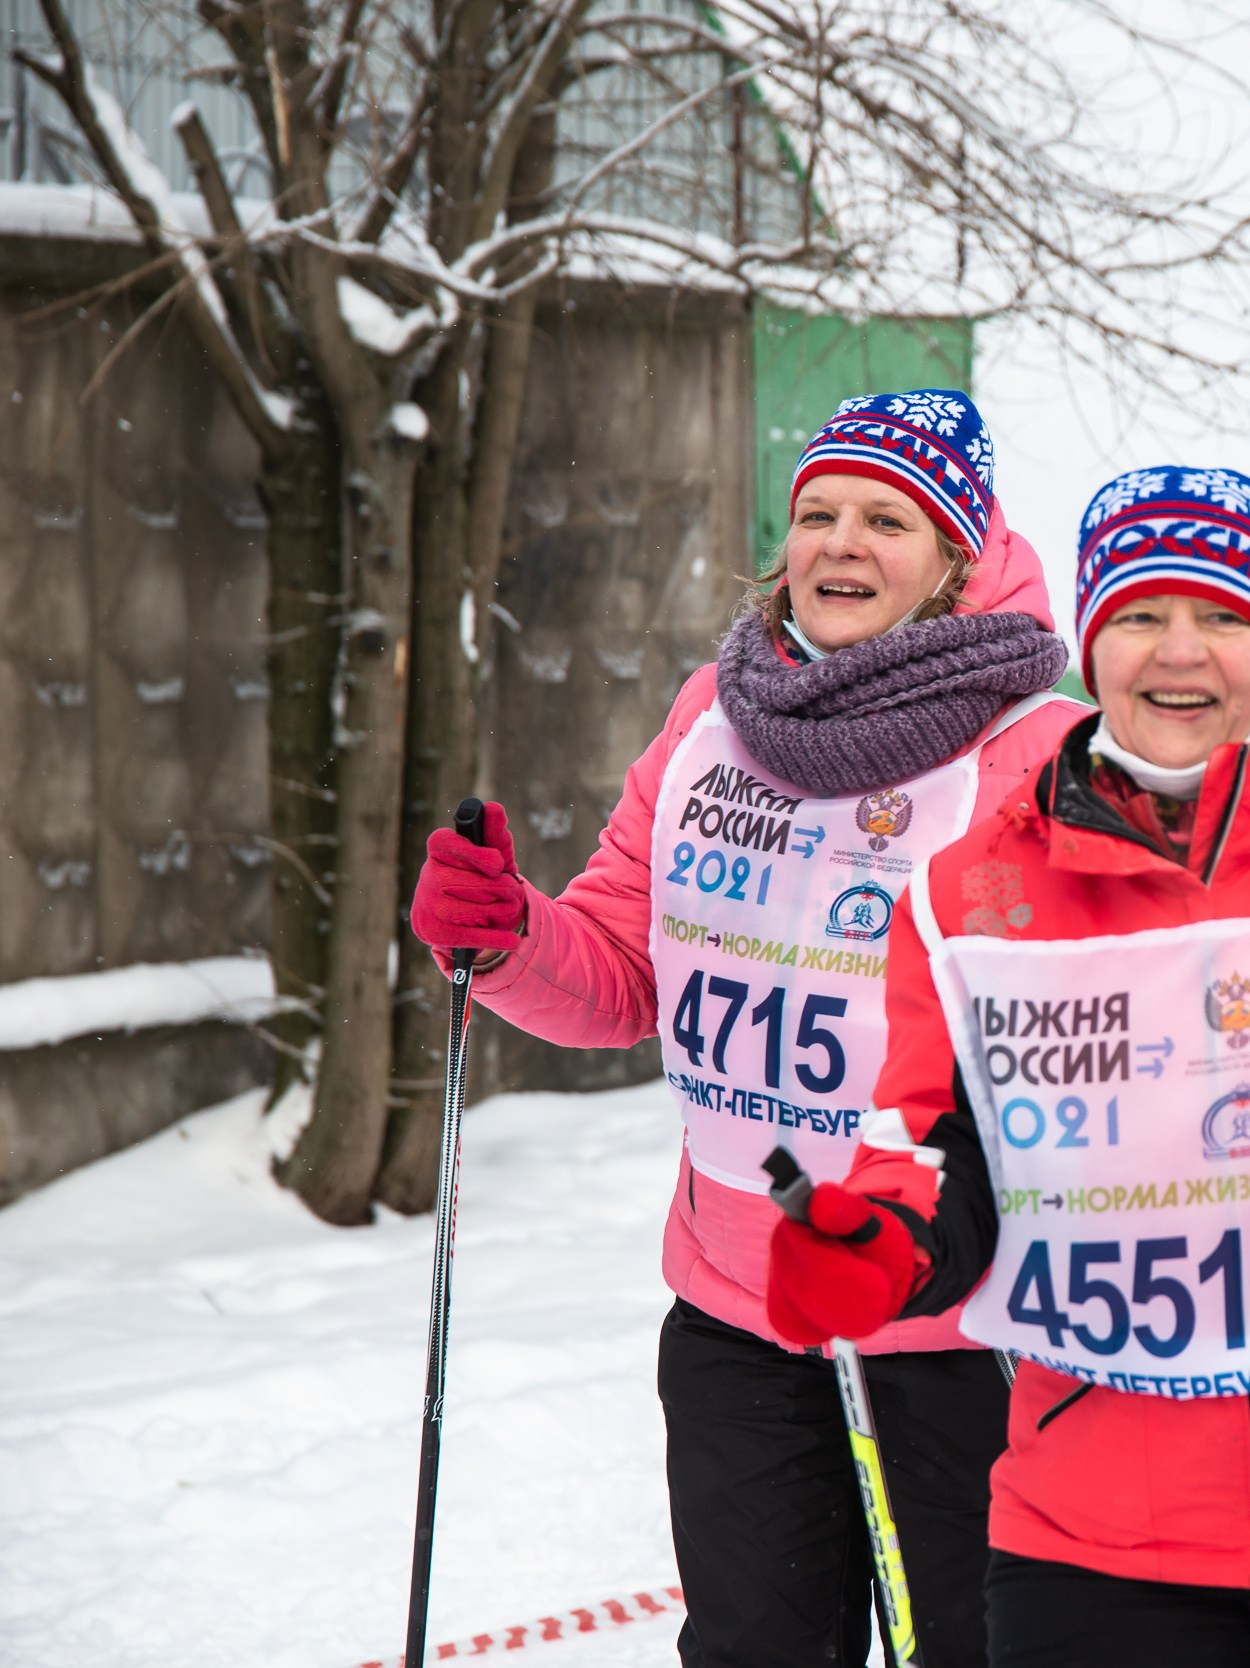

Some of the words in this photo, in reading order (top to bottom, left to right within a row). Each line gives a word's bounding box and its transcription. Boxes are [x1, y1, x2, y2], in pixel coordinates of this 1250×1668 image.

[690, 763, 804, 815] ЛЫЖНЯ
[679, 797, 791, 855] РОССИИ
[666, 841, 772, 906] 2021
[829, 856, 876, 869] РОССИЙСКОЙ
[833, 849, 887, 863] МИНИСТЕРСТВО
[887, 858, 912, 866] СПОРТА
[662, 913, 709, 949] СПОРТ
[722, 931, 799, 966] НОРМА
[799, 946, 888, 980] ЖИЗНИ
[673, 968, 848, 1094] 4715
[986, 1040, 1130, 1086] ОССИИ
[667, 1071, 868, 1138] САНКТ-ПЕТЕРБУР
[1002, 1095, 1120, 1149] 021
[1067, 1177, 1179, 1215] НОРМА
[1006, 1227, 1247, 1359] 4551
